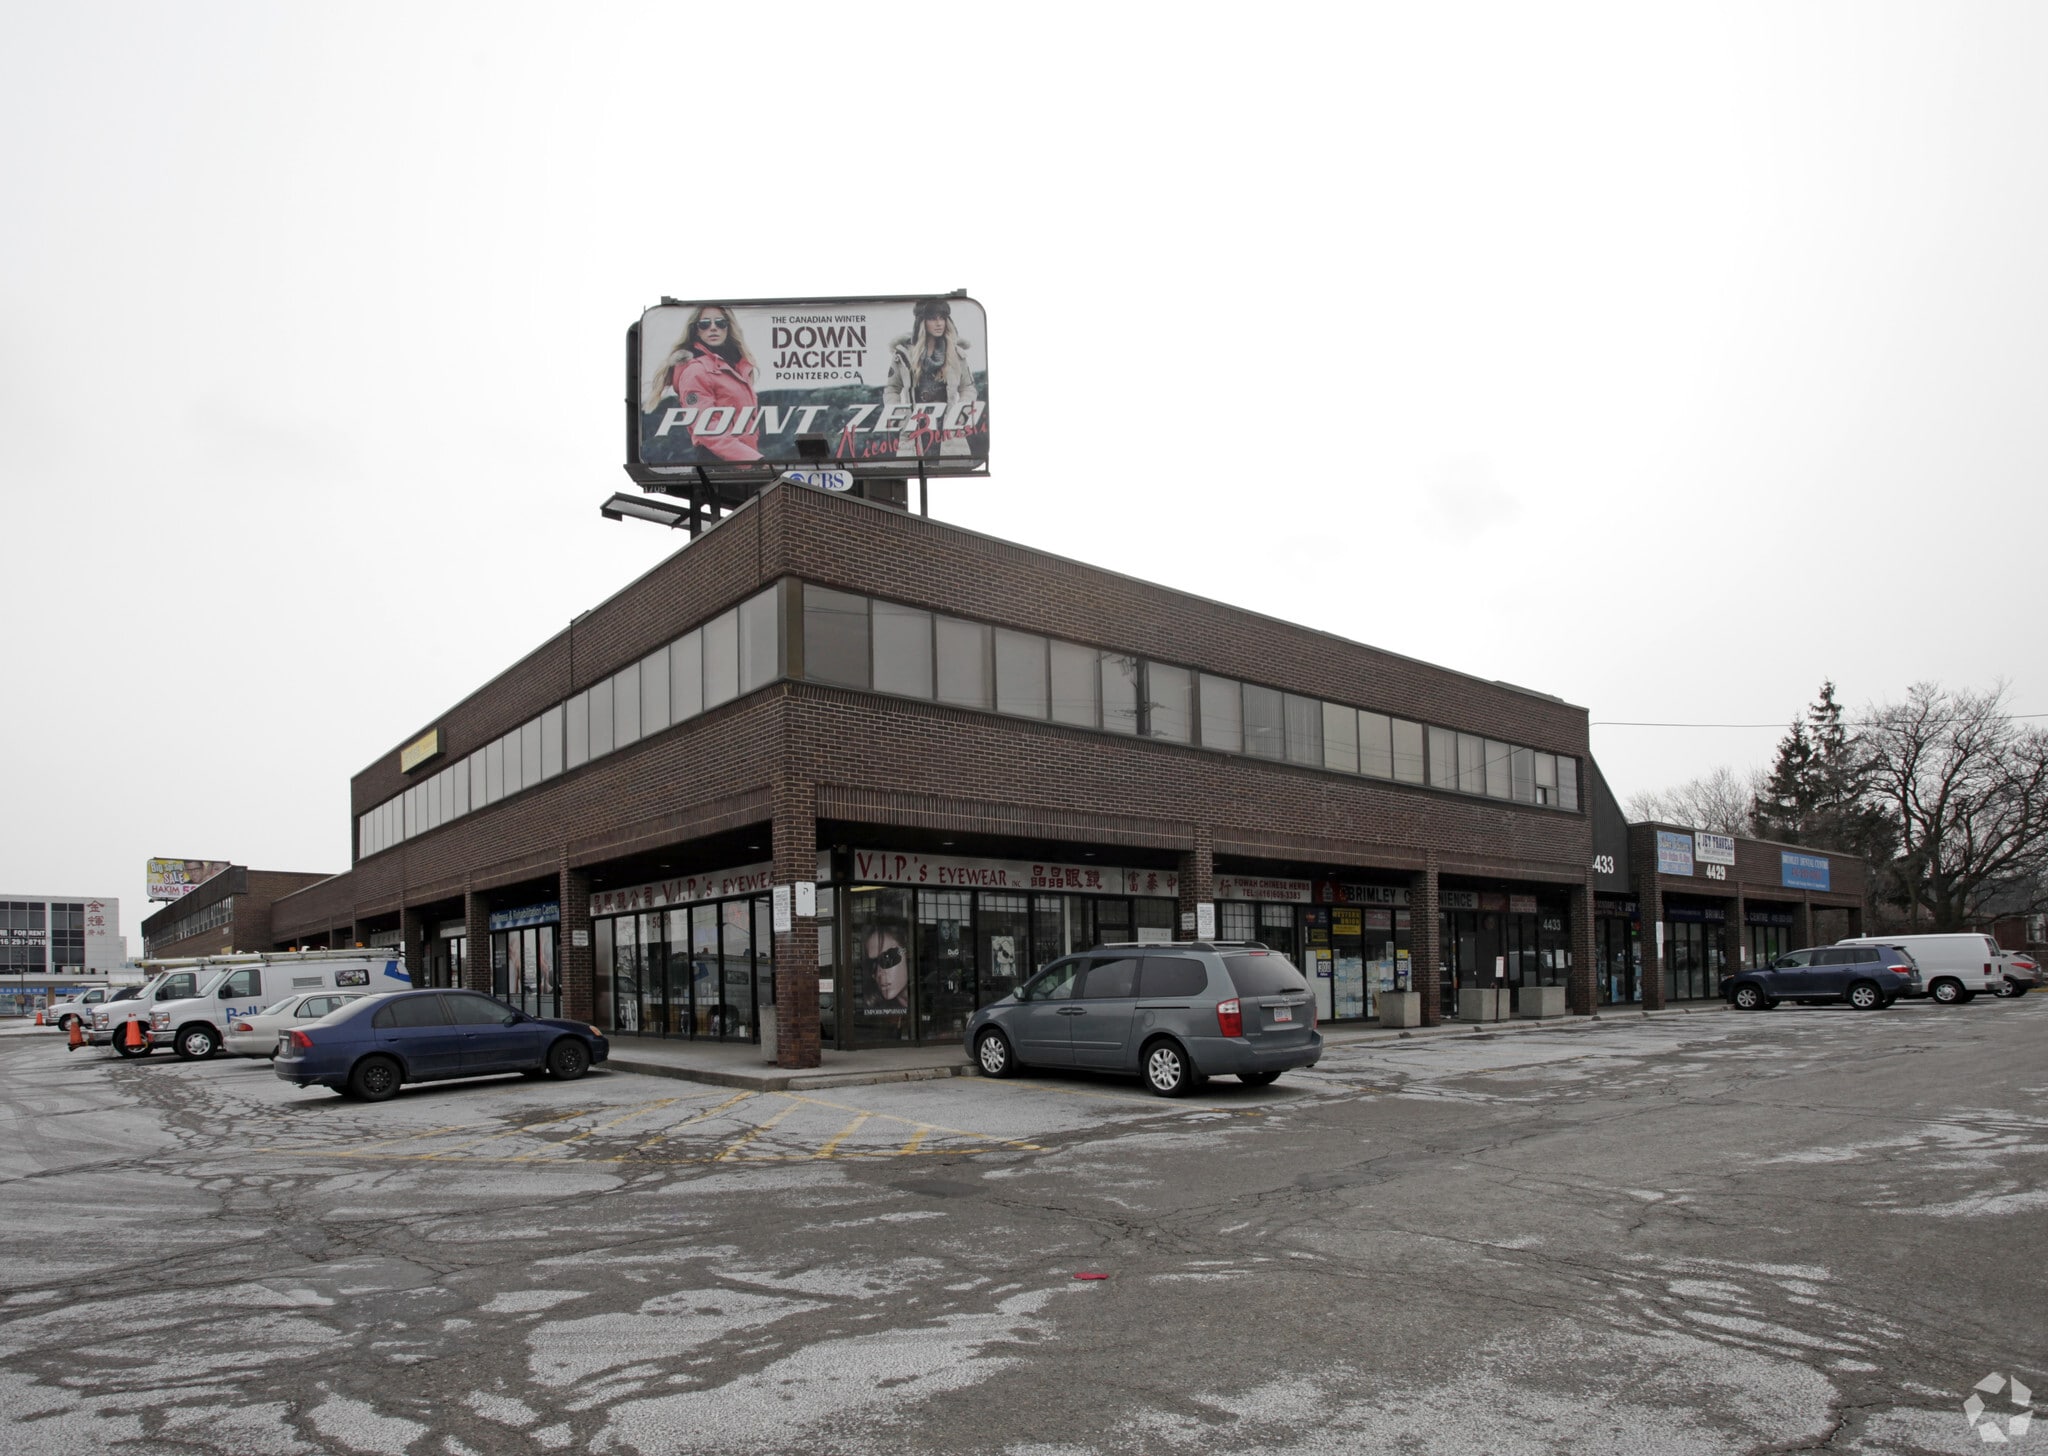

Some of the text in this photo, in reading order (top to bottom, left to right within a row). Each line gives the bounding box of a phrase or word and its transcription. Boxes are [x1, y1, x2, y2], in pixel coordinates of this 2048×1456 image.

[771, 316, 787, 324] THE
[772, 326, 867, 349] DOWN
[773, 350, 868, 368] JACKET
[654, 401, 986, 437] POINT ZERO
[807, 472, 845, 489] CBS
[1702, 834, 1712, 848] JET
[1712, 836, 1733, 850] TRAVELS
[856, 851, 928, 882] V.I.P.'s
[938, 865, 1008, 886] EYEWEAR
[1592, 855, 1615, 874] 433
[1706, 864, 1726, 881] 4429
[163, 870, 185, 885] SALE
[723, 871, 777, 894] EYEWEA
[1234, 879, 1258, 888] FOWAH
[1259, 880, 1287, 890] CHINESE
[152, 885, 180, 895] HAKIM
[1348, 887, 1397, 903] BRIMLEY
[1704, 908, 1725, 920] BRIMLE
[1543, 918, 1561, 931] 4433
